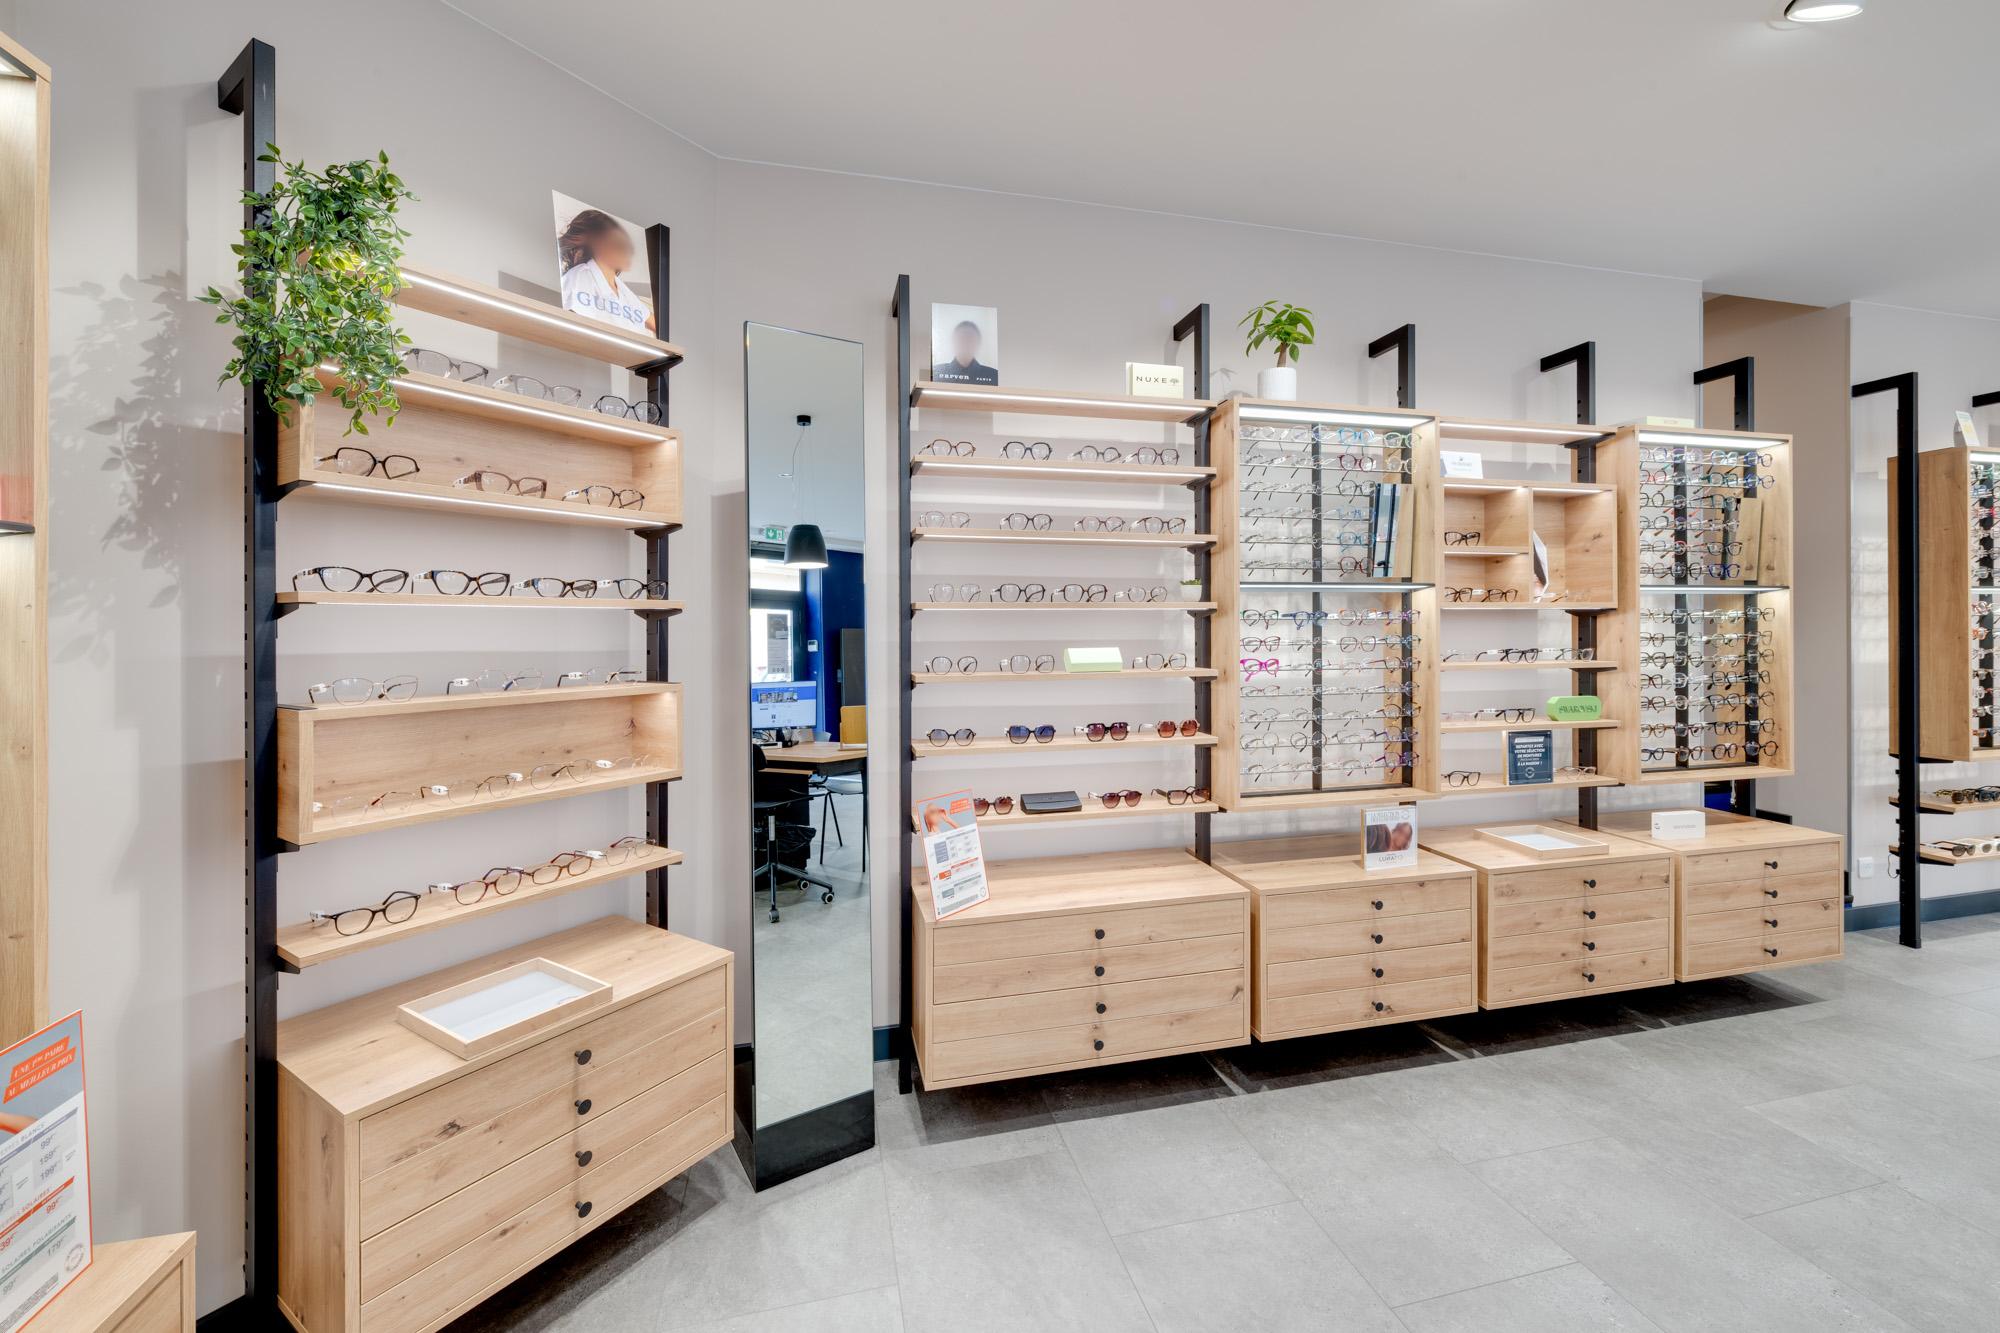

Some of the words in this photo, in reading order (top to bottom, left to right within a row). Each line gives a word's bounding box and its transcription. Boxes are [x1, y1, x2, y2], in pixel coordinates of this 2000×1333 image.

[576, 291, 645, 325] GUESS
[1136, 376, 1168, 384] NUXE
[44, 1044, 65, 1061] PAIRE
[19, 1062, 57, 1091] MEILLEUR
[57, 1053, 73, 1067] PRIX
